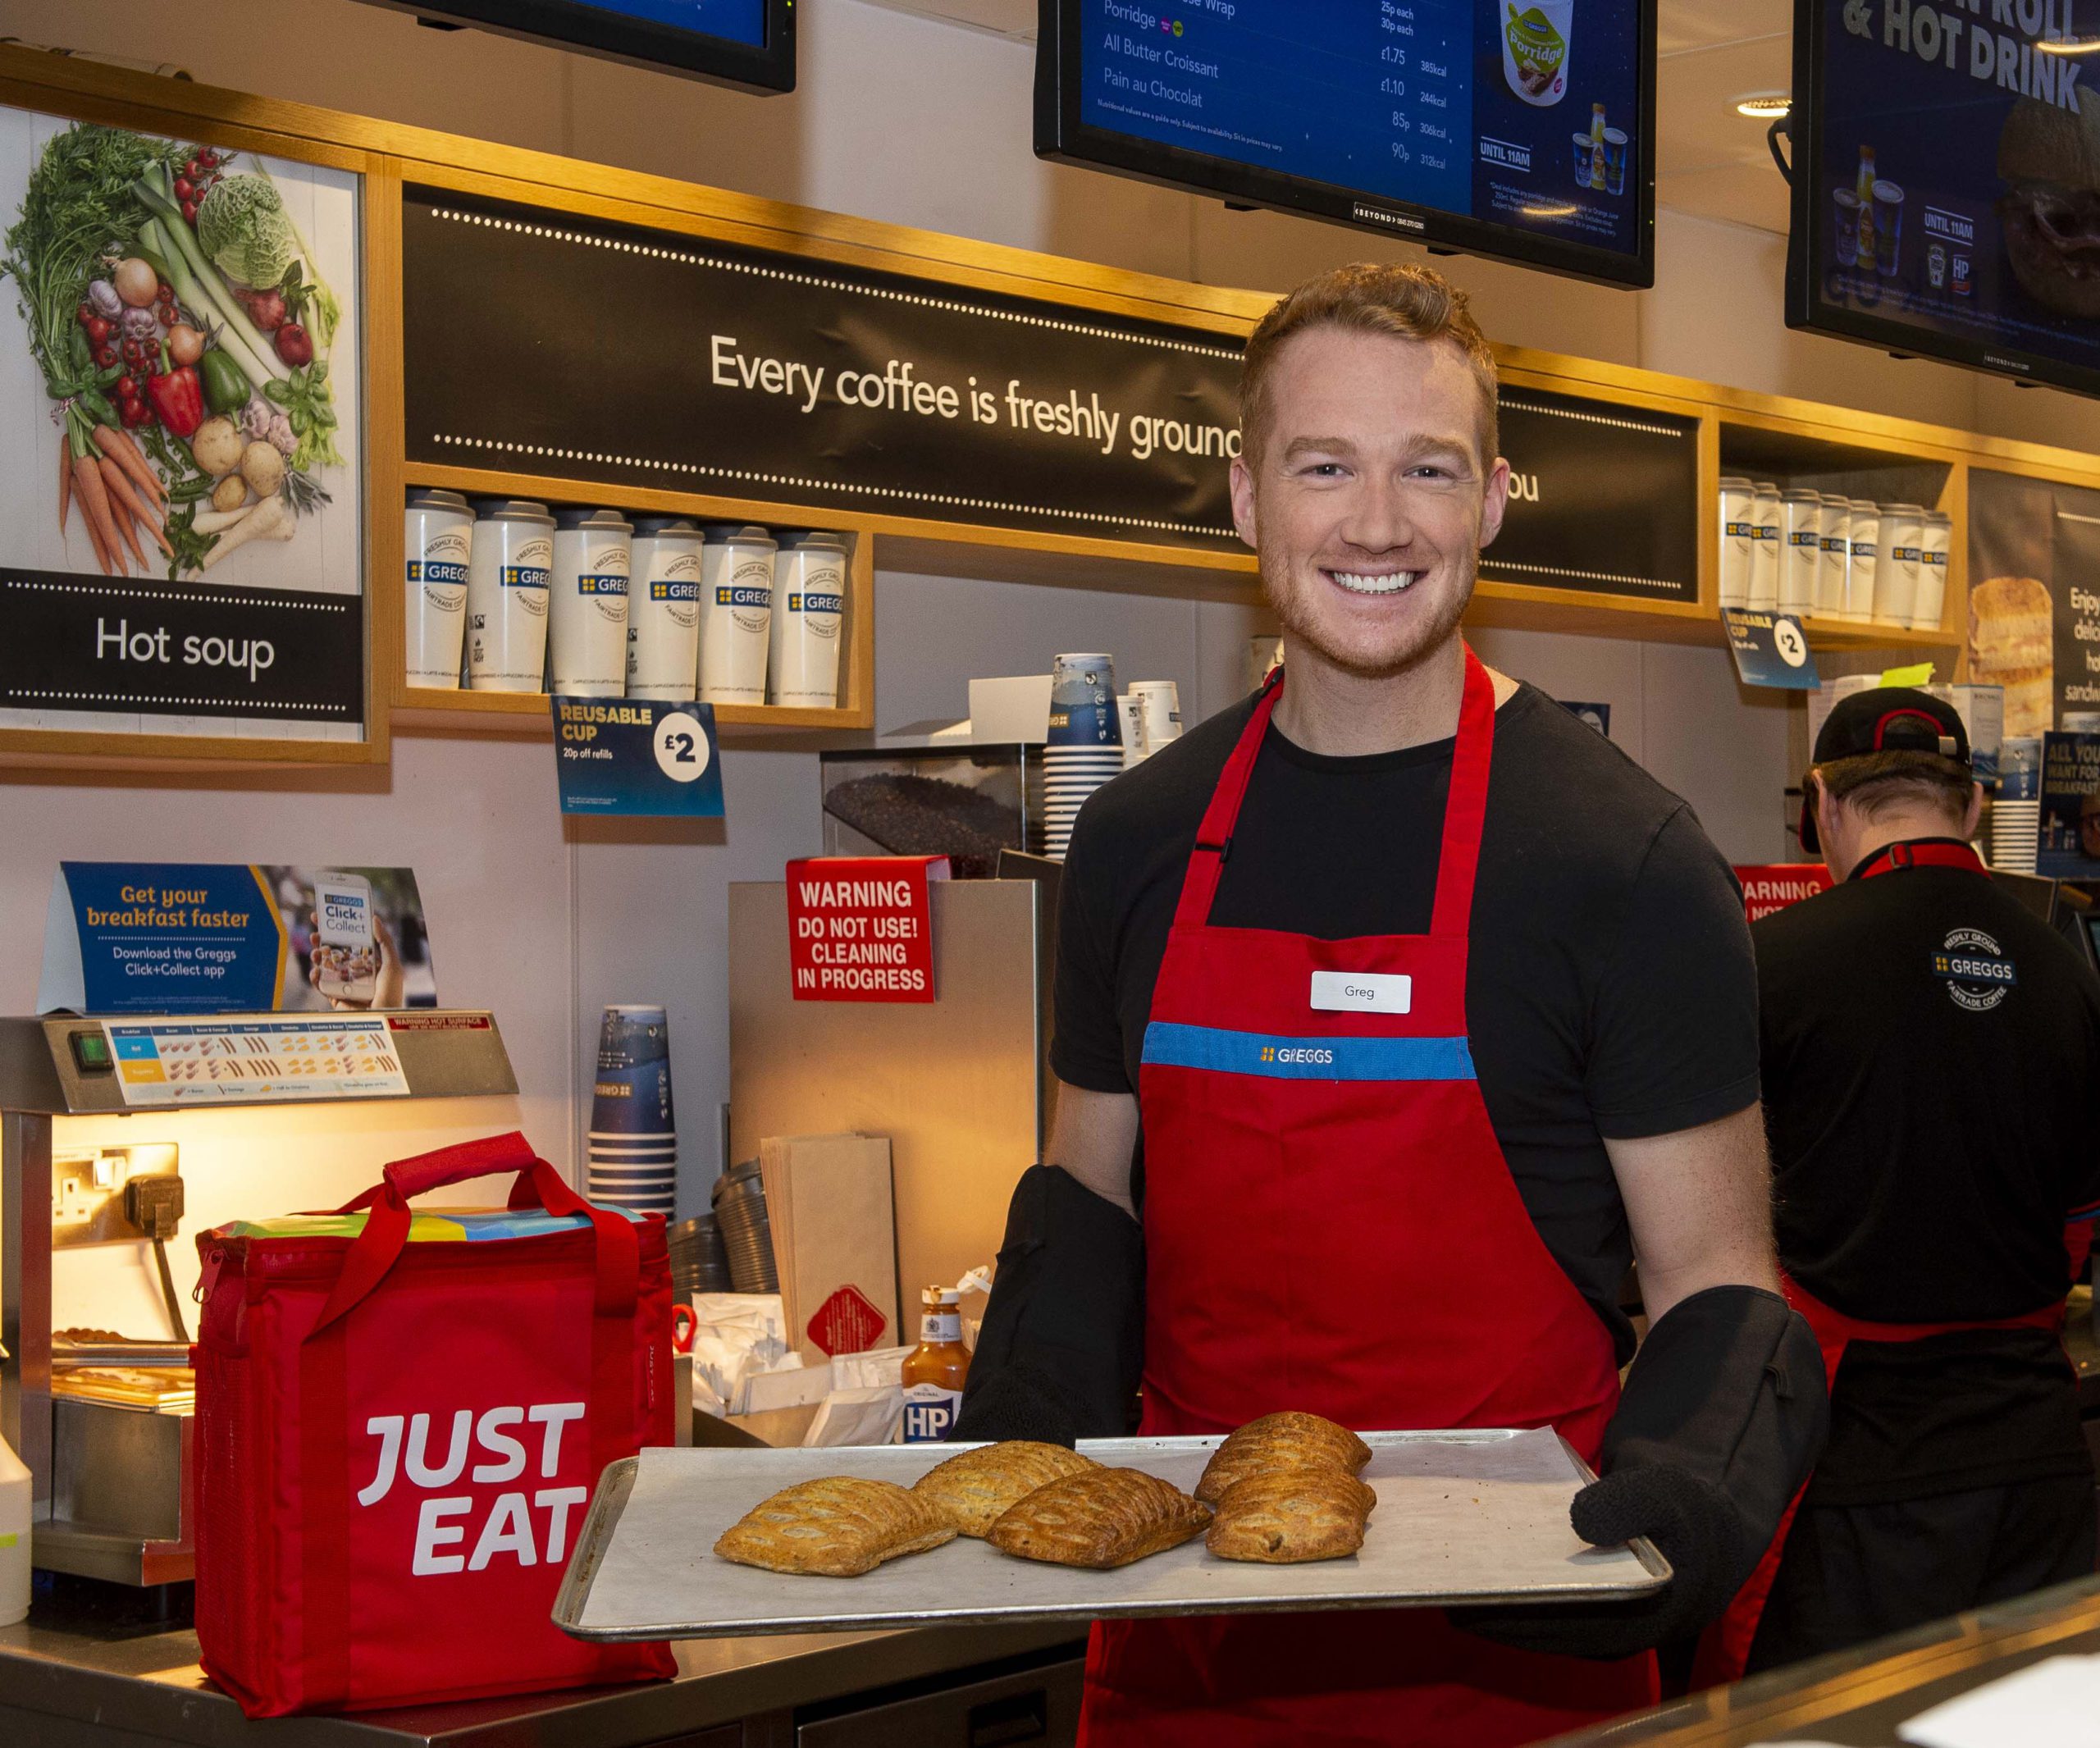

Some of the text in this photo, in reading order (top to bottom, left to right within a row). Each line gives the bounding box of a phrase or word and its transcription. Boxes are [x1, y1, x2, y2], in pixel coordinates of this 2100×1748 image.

[1104, 0, 1156, 29] Porridge
[1205, 0, 1235, 20] Wrap
[1381, 1, 1413, 20] 25p each
[1992, 0, 2079, 44] ROLL
[1381, 17, 1413, 36] 30p each
[1103, 33, 1219, 78] All Butter Croissant
[1381, 46, 1446, 77] £1.75 385kcal
[1842, 0, 2082, 115] & HOT DRINK
[1104, 67, 1203, 108] Pain au Chocolat
[1381, 78, 1446, 108] £1.10 244kcal
[1393, 112, 1446, 139] 85p 306kcal
[1392, 143, 1446, 170] 90p 312kcal
[1480, 142, 1531, 167] UNTIL 11AM
[1924, 212, 1974, 240] UNTIL 11AM
[1953, 258, 1969, 280] HP
[710, 335, 825, 413] Every
[835, 359, 960, 419] coffee
[968, 376, 998, 426] is
[1005, 380, 1121, 454] freshly
[1509, 471, 1540, 502] ou
[96, 617, 276, 683] Hot soup
[559, 705, 653, 726] REUSABLE
[561, 723, 696, 763] CUP £2
[564, 746, 613, 760] 20p off refills
[2048, 743, 2072, 761] ALL
[120, 885, 157, 905] Get
[162, 886, 208, 908] your
[798, 880, 912, 908] WARNING
[1740, 880, 1822, 901] ARNING
[86, 906, 187, 928] breakfast
[190, 907, 249, 928] faster
[326, 919, 366, 933] Collect
[797, 917, 918, 938] DO NOT USE!
[112, 947, 237, 963] Download the Greggs
[811, 942, 906, 965] CLEANING
[1971, 933, 2002, 956] GROUND
[125, 962, 225, 979] Click+Collect app
[797, 968, 925, 990] IN PROGRESS
[1952, 959, 2012, 979] GREGGS
[1344, 984, 1375, 1001] Greg
[1947, 980, 2007, 1007] FAIRTRADE COFFEE
[1277, 1048, 1333, 1064] GREGGS
[906, 1406, 949, 1438] HP
[357, 1402, 586, 1507] JUST
[412, 1486, 587, 1577] EAT
